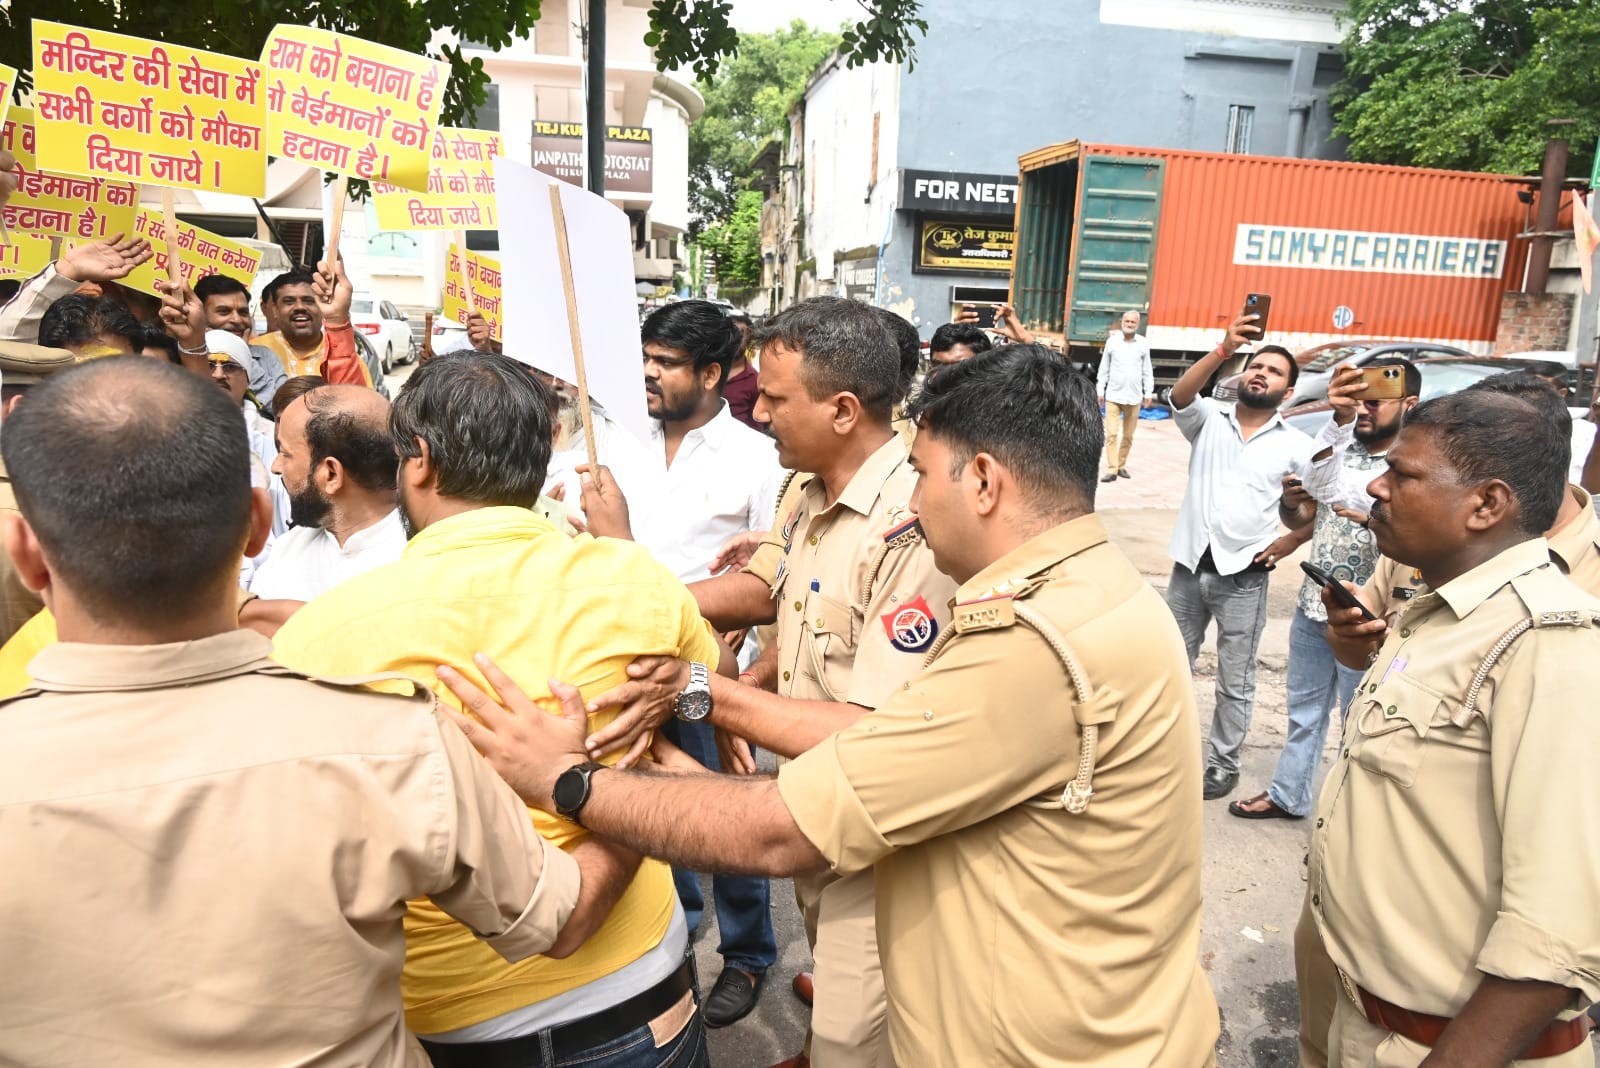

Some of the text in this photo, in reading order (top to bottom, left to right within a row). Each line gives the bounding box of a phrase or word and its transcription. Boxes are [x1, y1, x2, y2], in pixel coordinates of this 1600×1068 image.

[40, 32, 260, 104] मन्दिर की सेवा में
[270, 37, 439, 111] राम को बचाना है
[38, 86, 94, 125] सभी
[160, 105, 194, 140] को
[202, 110, 260, 150] मौका
[291, 86, 391, 138] बेईमानों
[392, 118, 430, 150] को
[534, 122, 559, 135] TEJ
[608, 127, 651, 141] PLAZA
[87, 134, 142, 177] दिया
[149, 150, 202, 184] जाये
[283, 130, 351, 168] हटाना
[451, 134, 483, 161] सेवा
[534, 150, 583, 167] JANPATH
[447, 169, 470, 194] को
[556, 168, 569, 177] TEJ
[107, 182, 137, 207] को
[914, 179, 1018, 203] FOR NEET
[3, 205, 72, 232] हटाना
[408, 199, 444, 226] दिया
[446, 200, 481, 225] जाये
[964, 226, 986, 239] तेज
[197, 240, 220, 260] बात
[222, 248, 256, 273] करेगा
[446, 280, 457, 298] तो
